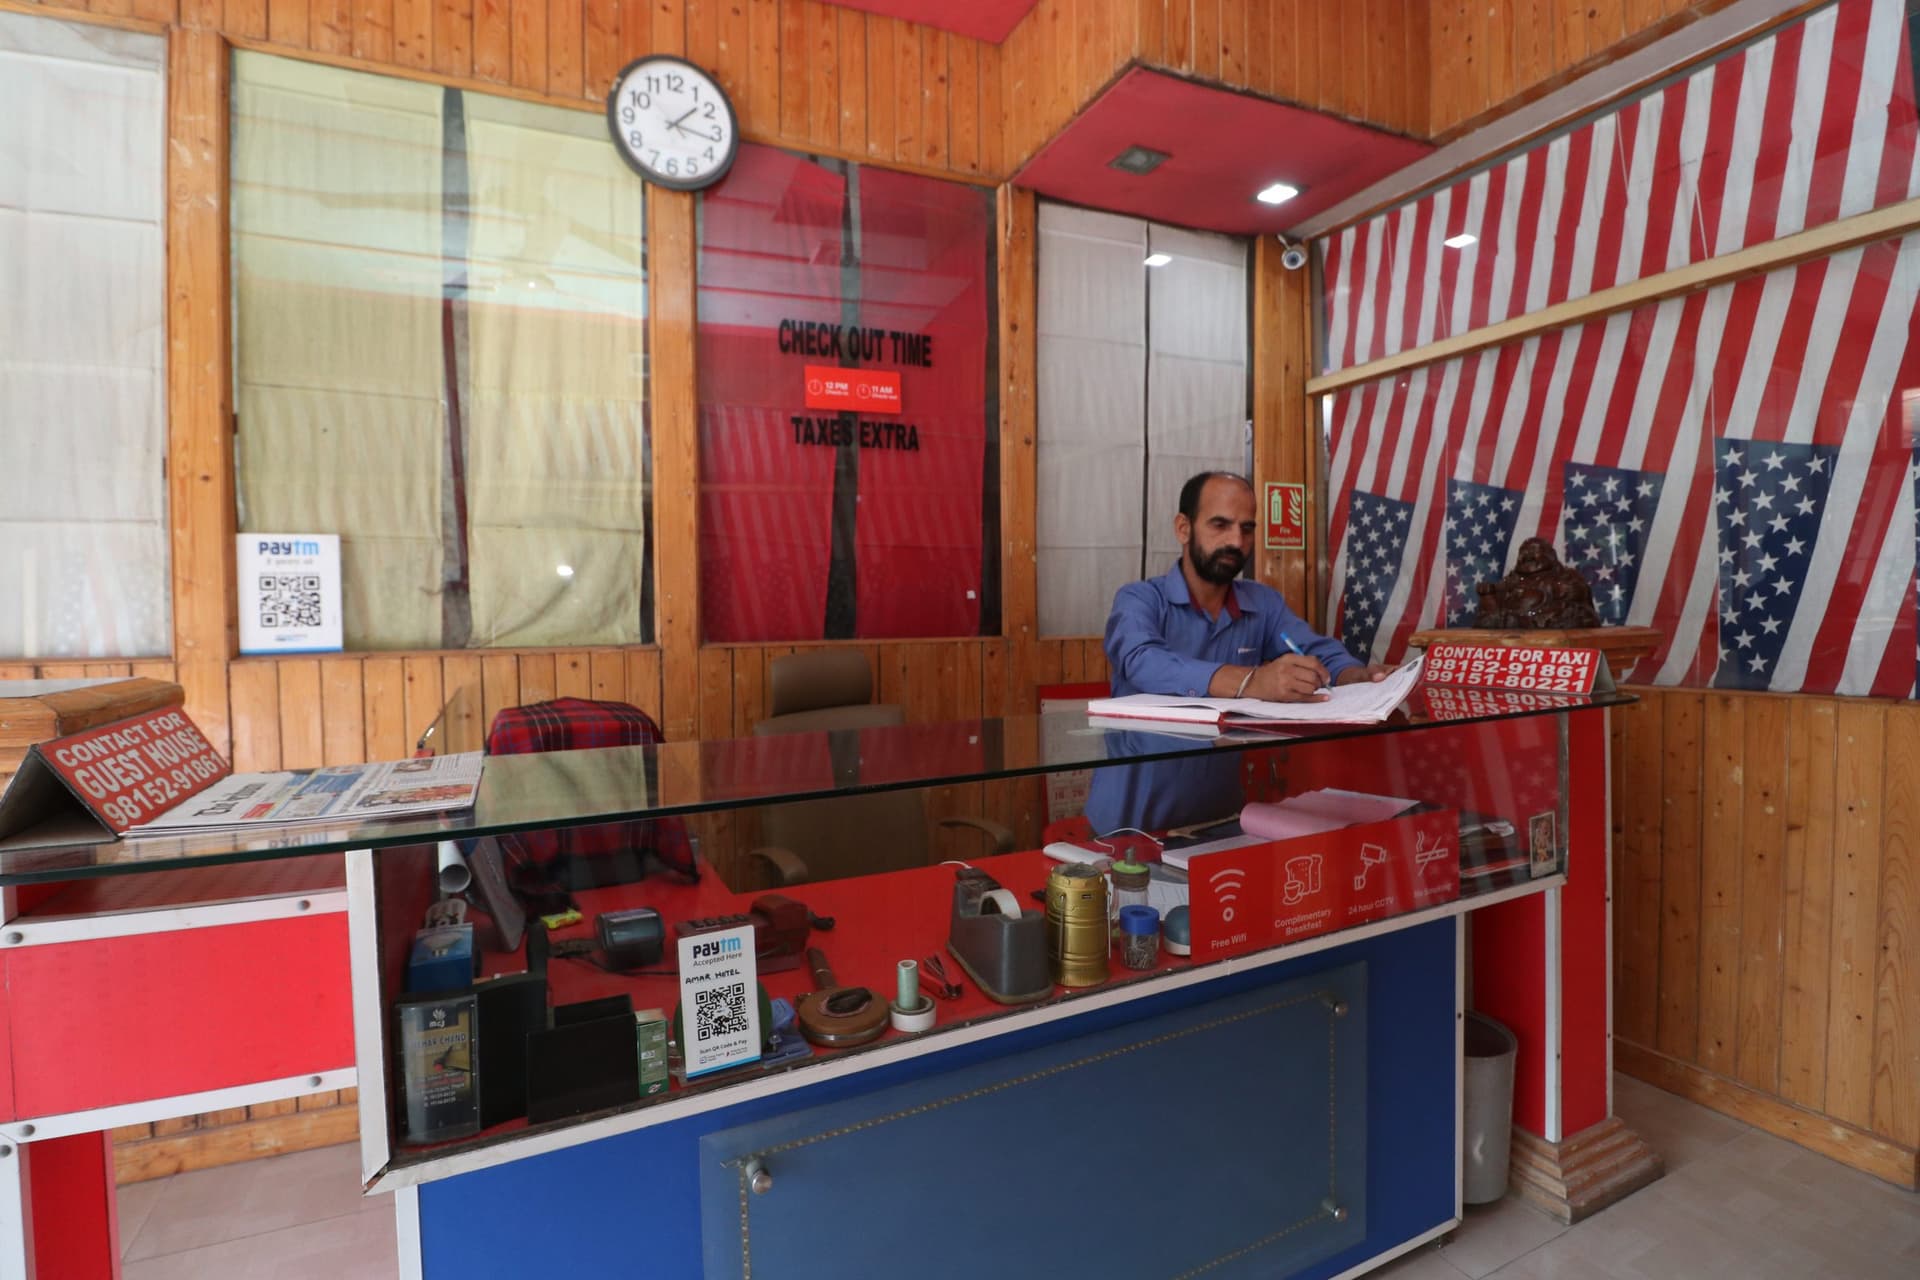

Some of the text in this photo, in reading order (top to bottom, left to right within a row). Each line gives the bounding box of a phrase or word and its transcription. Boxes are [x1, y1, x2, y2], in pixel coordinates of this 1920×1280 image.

[646, 74, 660, 94] 11
[665, 72, 684, 94] 12
[629, 89, 651, 110] 10
[692, 85, 698, 103] 1
[622, 105, 635, 125] 9
[703, 100, 716, 120] 2
[629, 129, 643, 149] 8
[711, 124, 722, 142] 3
[648, 148, 660, 166] 7
[703, 145, 714, 163] 4
[666, 157, 679, 176] 6
[686, 158, 698, 175] 5
[778, 318, 932, 368] CHECK OUT TIME
[835, 382, 848, 390] PM
[879, 386, 894, 394] AM
[791, 416, 920, 451] TAXES EXTRA
[1433, 646, 1591, 666] CONTACT FOR TAXI
[1429, 658, 1589, 679] 98152-91861
[1426, 670, 1585, 693] 99151-80221
[56, 712, 186, 767] CONTACT FOR
[74, 727, 208, 799] GUEST HOUSE
[103, 752, 225, 826] 98152-91861
[1357, 901, 1375, 913] hour
[1375, 896, 1394, 908] CCTV
[1274, 908, 1332, 929] Complimentary
[1211, 932, 1247, 949] Free Wifi
[693, 951, 743, 967] Accepted Here
[685, 973, 711, 985] AMAR
